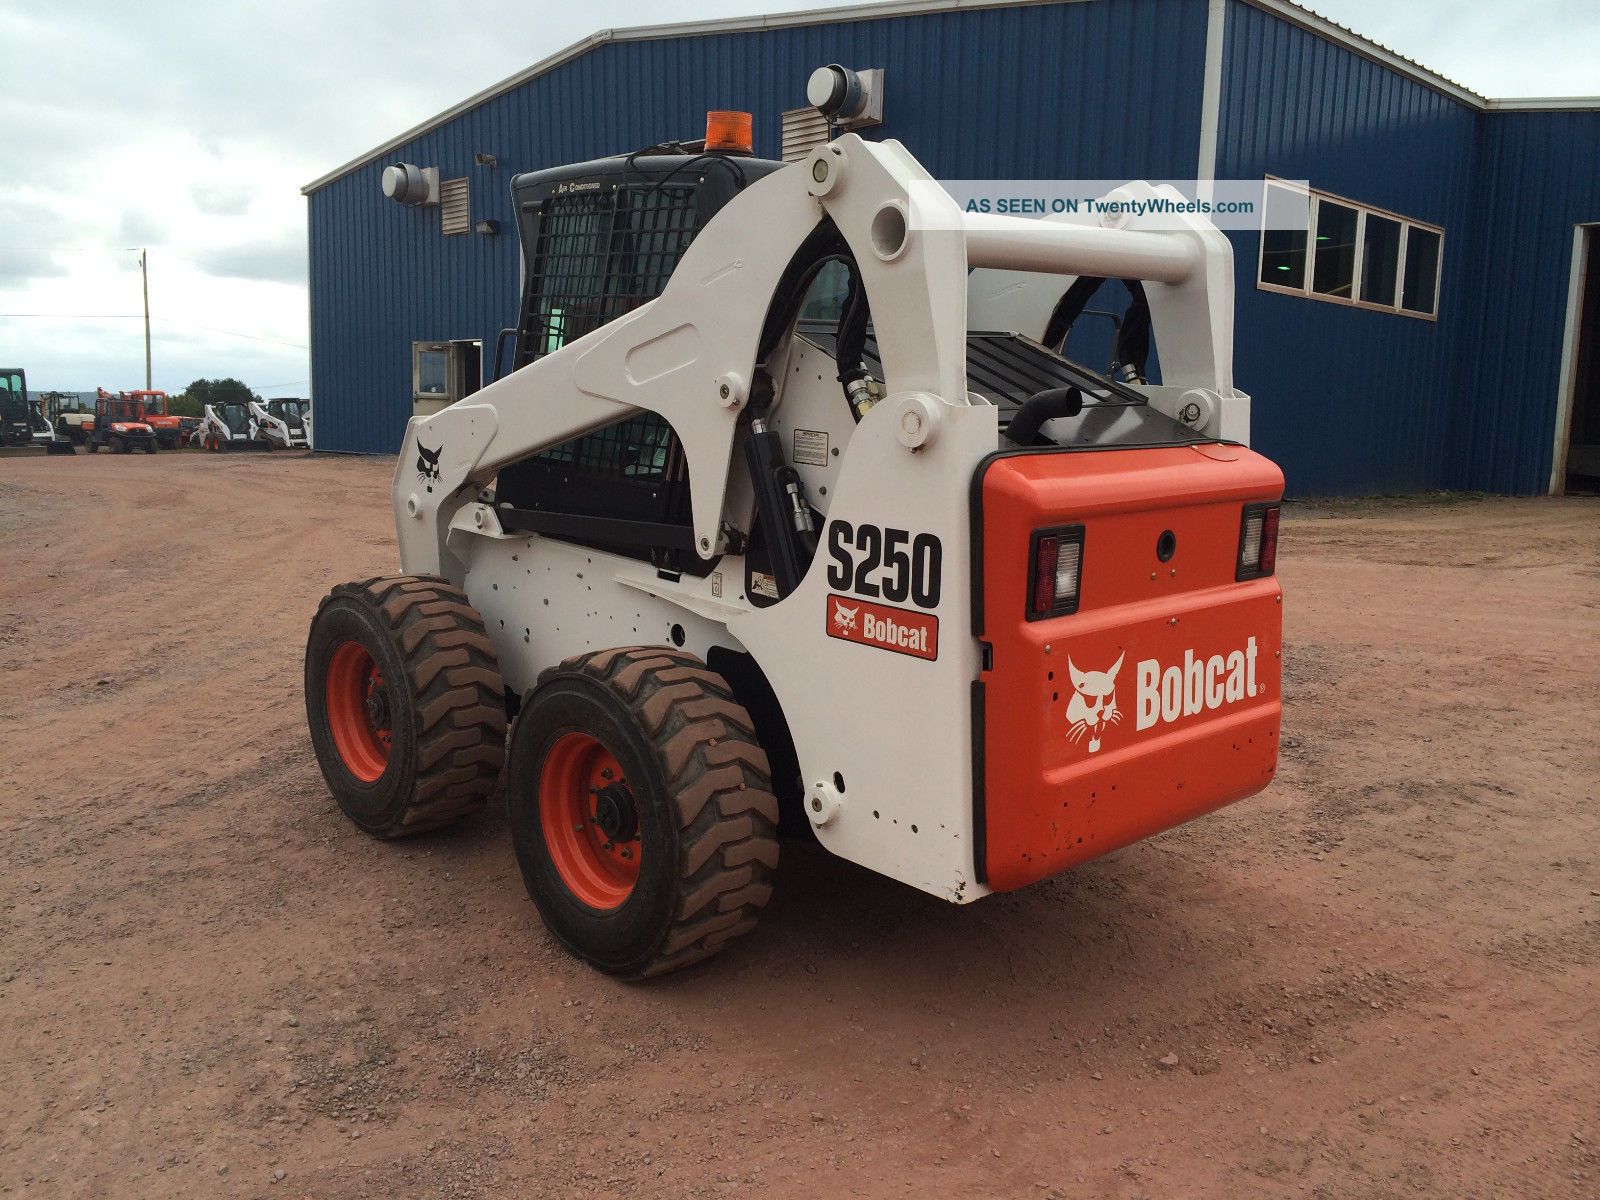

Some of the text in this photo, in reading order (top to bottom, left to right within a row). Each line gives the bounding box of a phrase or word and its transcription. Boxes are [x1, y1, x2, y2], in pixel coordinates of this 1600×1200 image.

[827, 519, 943, 609] S250
[863, 612, 928, 652] Bobcat
[1135, 635, 1258, 732] Bobcat
